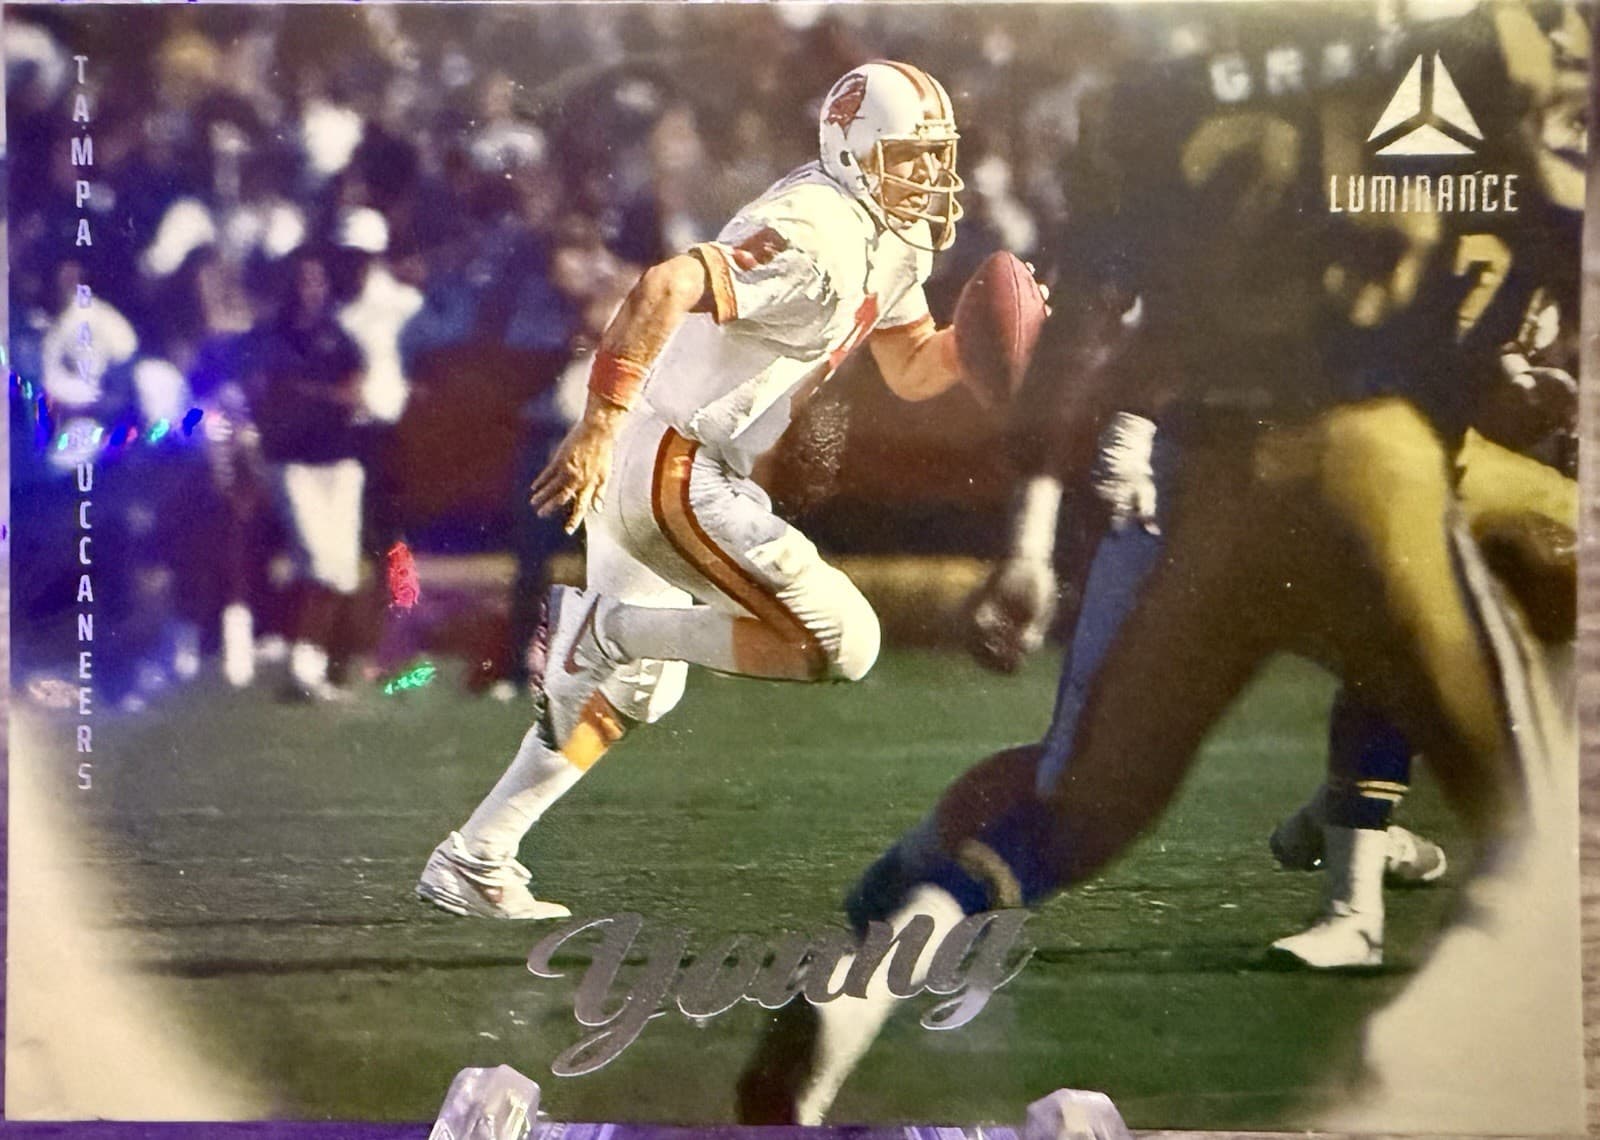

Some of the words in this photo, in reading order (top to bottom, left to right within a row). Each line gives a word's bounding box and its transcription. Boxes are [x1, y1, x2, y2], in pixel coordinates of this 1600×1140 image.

[71, 55, 94, 247] TAMPA
[1329, 174, 1519, 213] LUMINANCE
[76, 424, 94, 790] UCCANEERS
